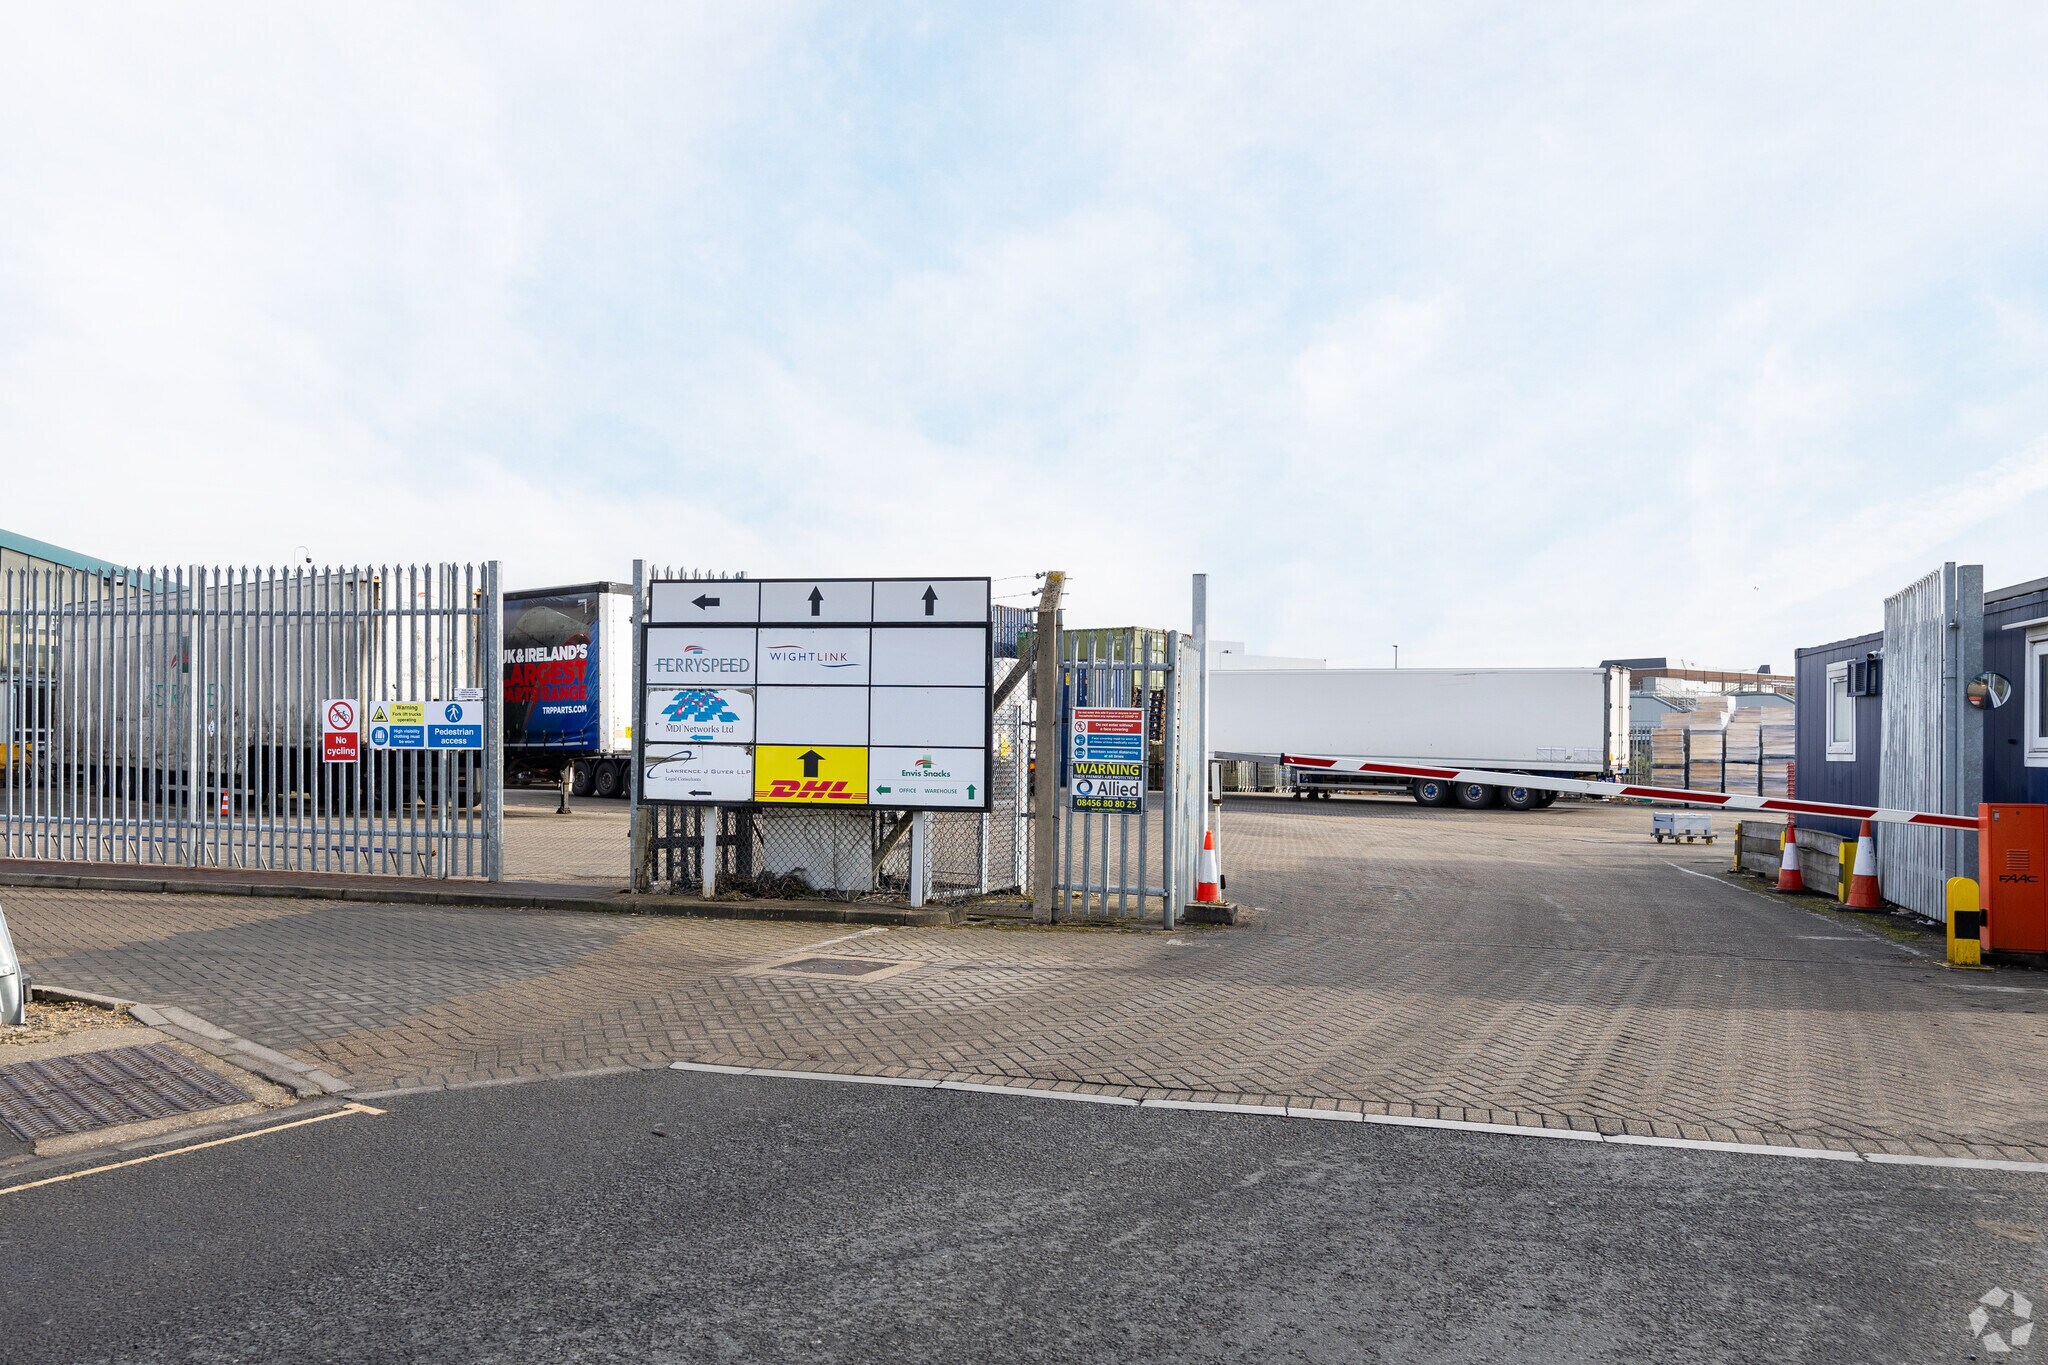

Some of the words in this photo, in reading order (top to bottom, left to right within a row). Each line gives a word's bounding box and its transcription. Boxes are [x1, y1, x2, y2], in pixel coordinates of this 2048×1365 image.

[770, 652, 847, 661] WIGHTLINK
[655, 658, 749, 672] FERRYSPEED
[542, 684, 587, 702] RANGE
[542, 705, 587, 714] TRPPARTS.COM
[335, 736, 346, 744] No
[327, 747, 355, 757] cycling
[1076, 763, 1139, 776] WARNING
[769, 780, 853, 799] DHL
[1097, 780, 1138, 796] Allied
[2000, 874, 2039, 883] FAAC
